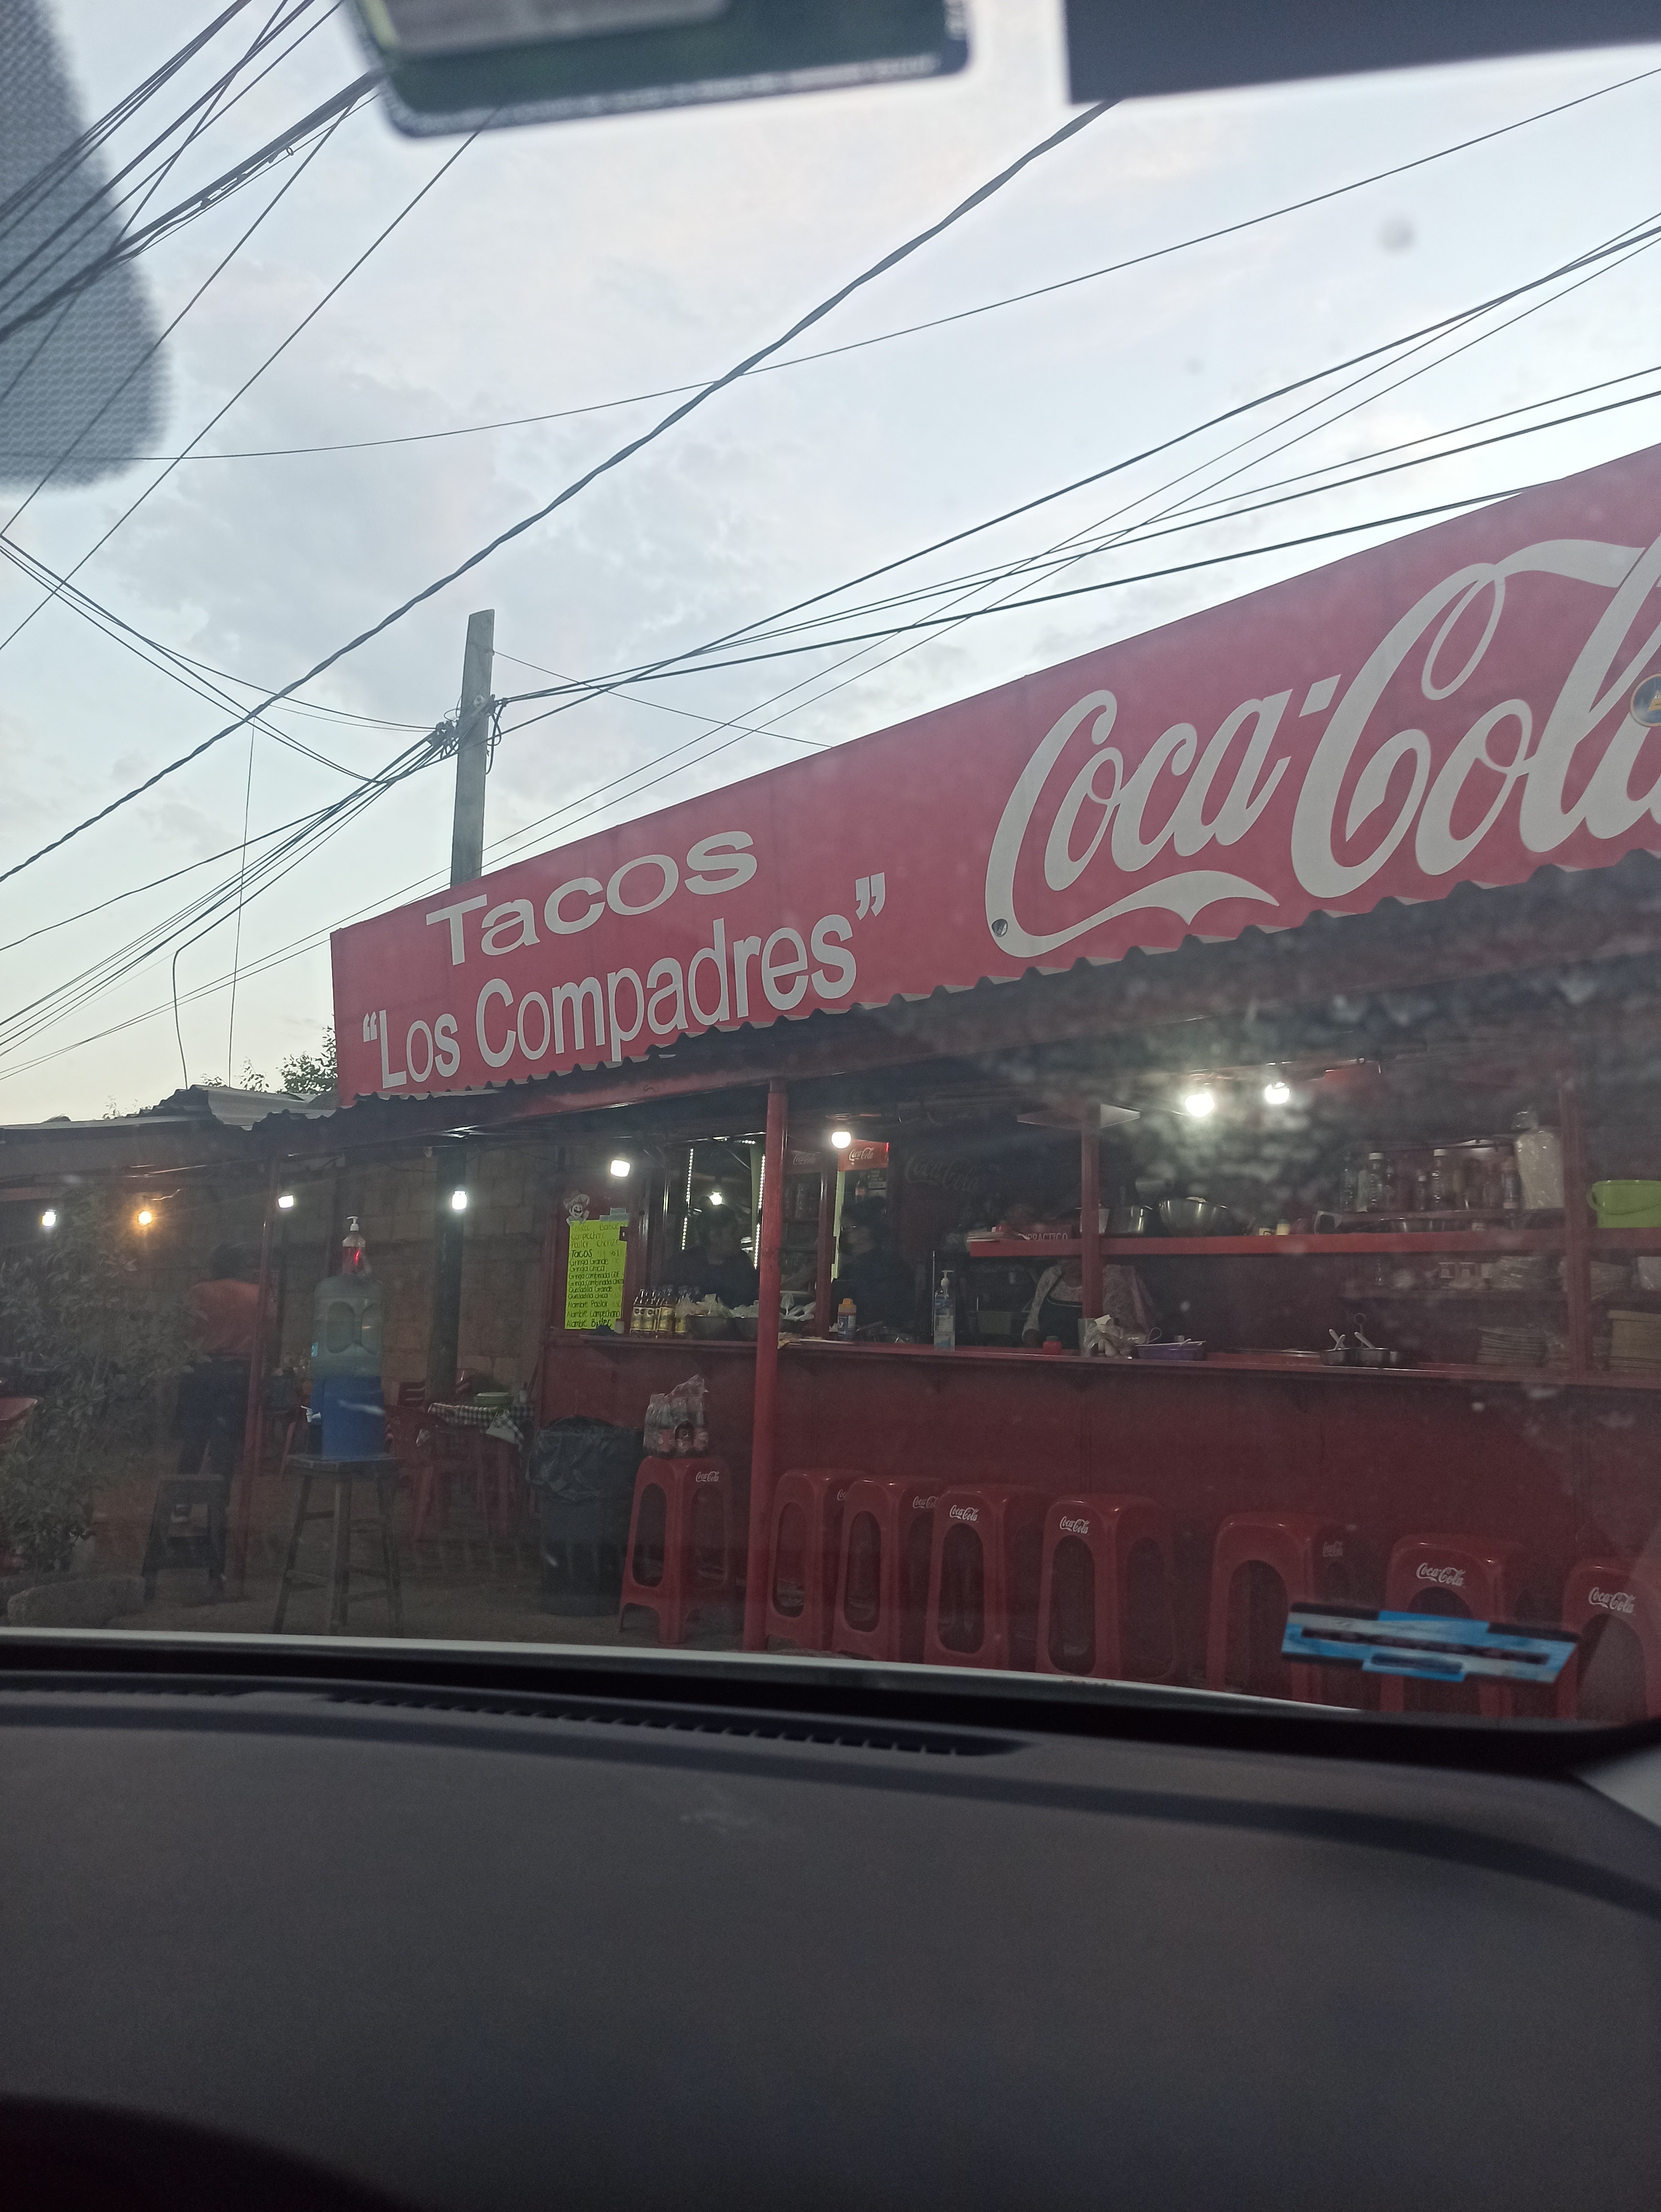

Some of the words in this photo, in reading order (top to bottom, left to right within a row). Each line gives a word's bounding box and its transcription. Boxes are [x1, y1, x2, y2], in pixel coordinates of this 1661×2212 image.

[426, 830, 757, 966] Tacos
[570, 1258, 588, 1266] Gringa
[566, 1319, 588, 1327] Alambre
[912, 1496, 938, 1509] Coca-Col
[949, 1504, 979, 1522] Coca-Cola
[1059, 1516, 1090, 1534] Coca-Cola
[1416, 1562, 1466, 1586] Coca-Cola
[1588, 1587, 1636, 1614] Coca-Cola
